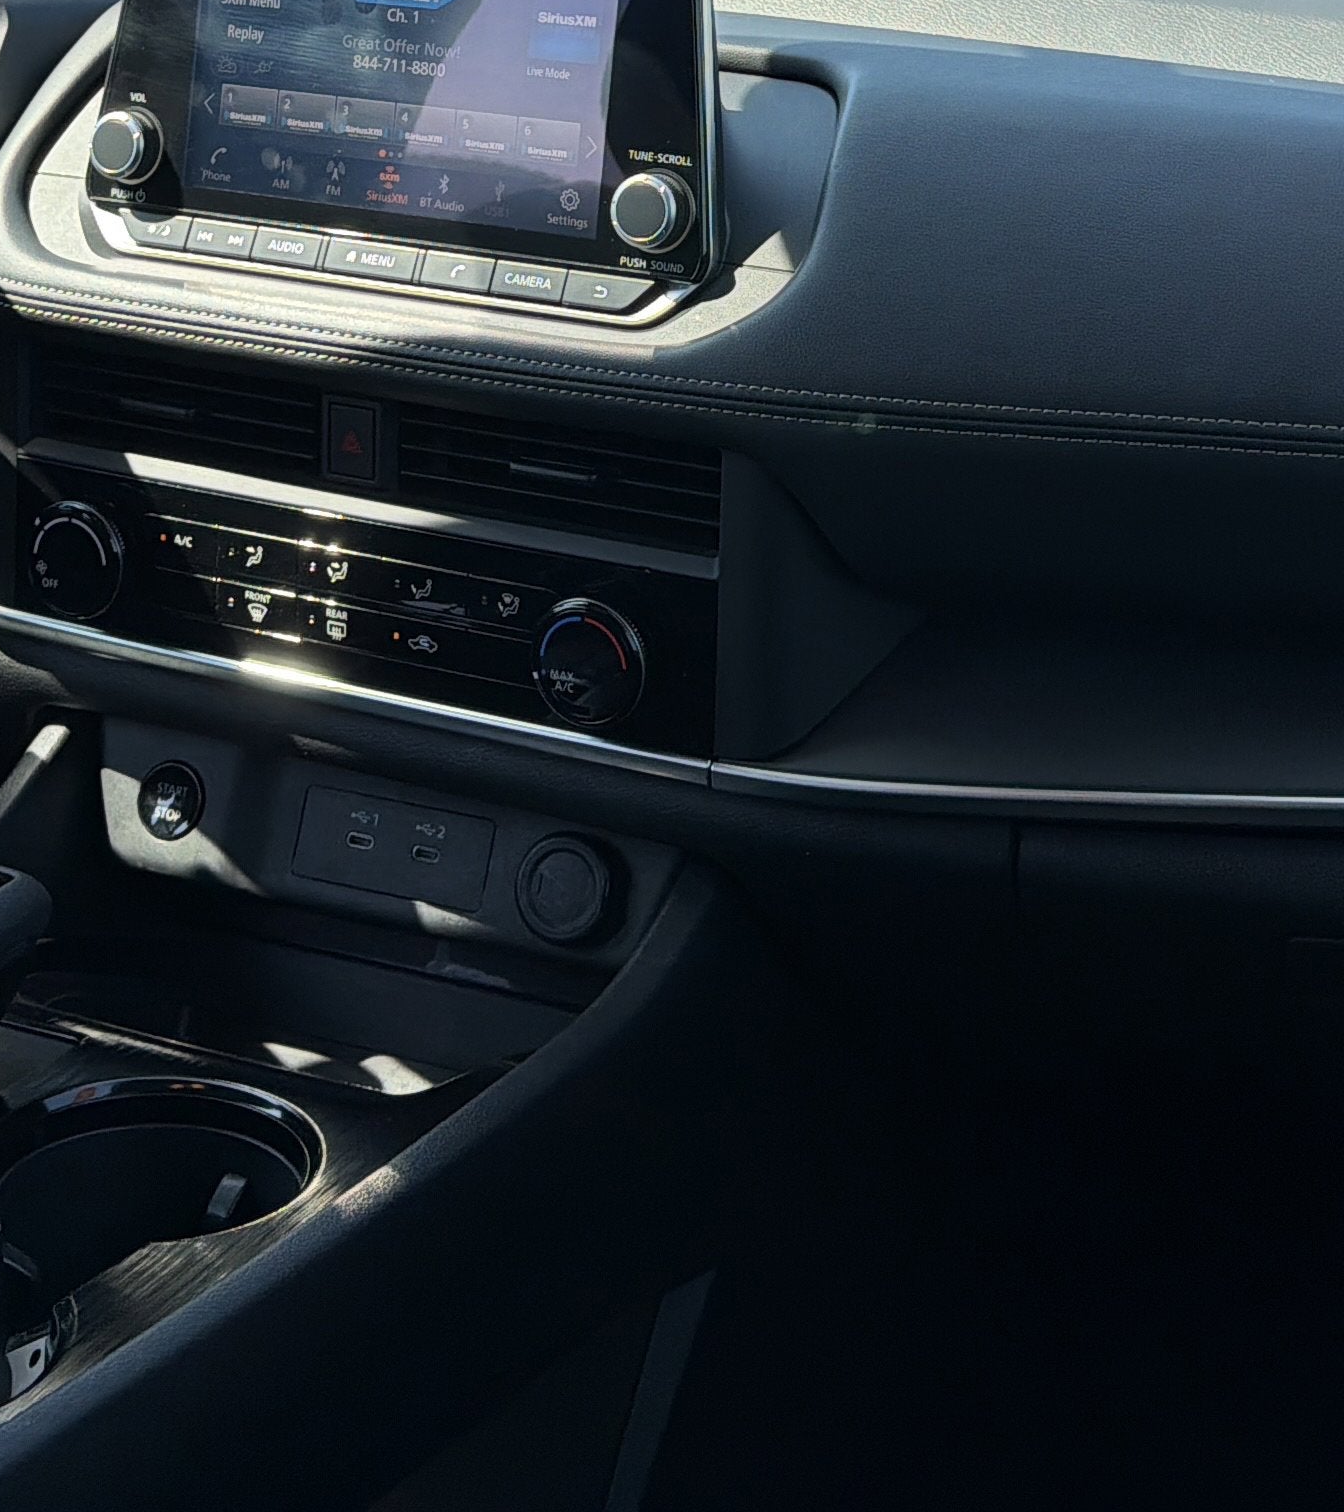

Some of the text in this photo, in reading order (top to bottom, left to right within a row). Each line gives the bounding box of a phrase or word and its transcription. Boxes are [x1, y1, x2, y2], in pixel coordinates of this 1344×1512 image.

[387, 8, 419, 24] Ch. 1
[227, 24, 264, 45] Replay
[342, 34, 461, 59] Great Offer Now!
[353, 55, 446, 78] 844-711-8800
[527, 67, 570, 80] Live Mode
[130, 92, 147, 103] VOL
[228, 93, 233, 104] 1
[284, 98, 291, 110] 2
[342, 105, 349, 116] 3
[401, 112, 409, 122] 4
[462, 119, 469, 130] 5
[524, 125, 531, 136] 6
[628, 149, 693, 166] TUNE-SCROLL
[203, 168, 231, 183] Phone
[272, 178, 291, 190] AM
[326, 185, 341, 196] FM
[110, 187, 134, 199] PUSH
[366, 190, 409, 206] SiriusXM
[419, 196, 465, 213] BT Audio
[546, 212, 589, 229] Settings
[268, 239, 304, 255] AUDIO
[360, 252, 396, 268] MENU
[619, 255, 684, 274] PUSH SOUND
[504, 272, 552, 290] CAMERA
[174, 534, 193, 548] A/C
[42, 577, 59, 588] OFF
[244, 590, 272, 604] FRONT
[326, 607, 348, 621] REAR
[549, 668, 574, 681] MAX
[555, 681, 574, 693] A/C
[157, 782, 188, 797] START
[372, 813, 379, 826] 1
[437, 825, 446, 839] 2
